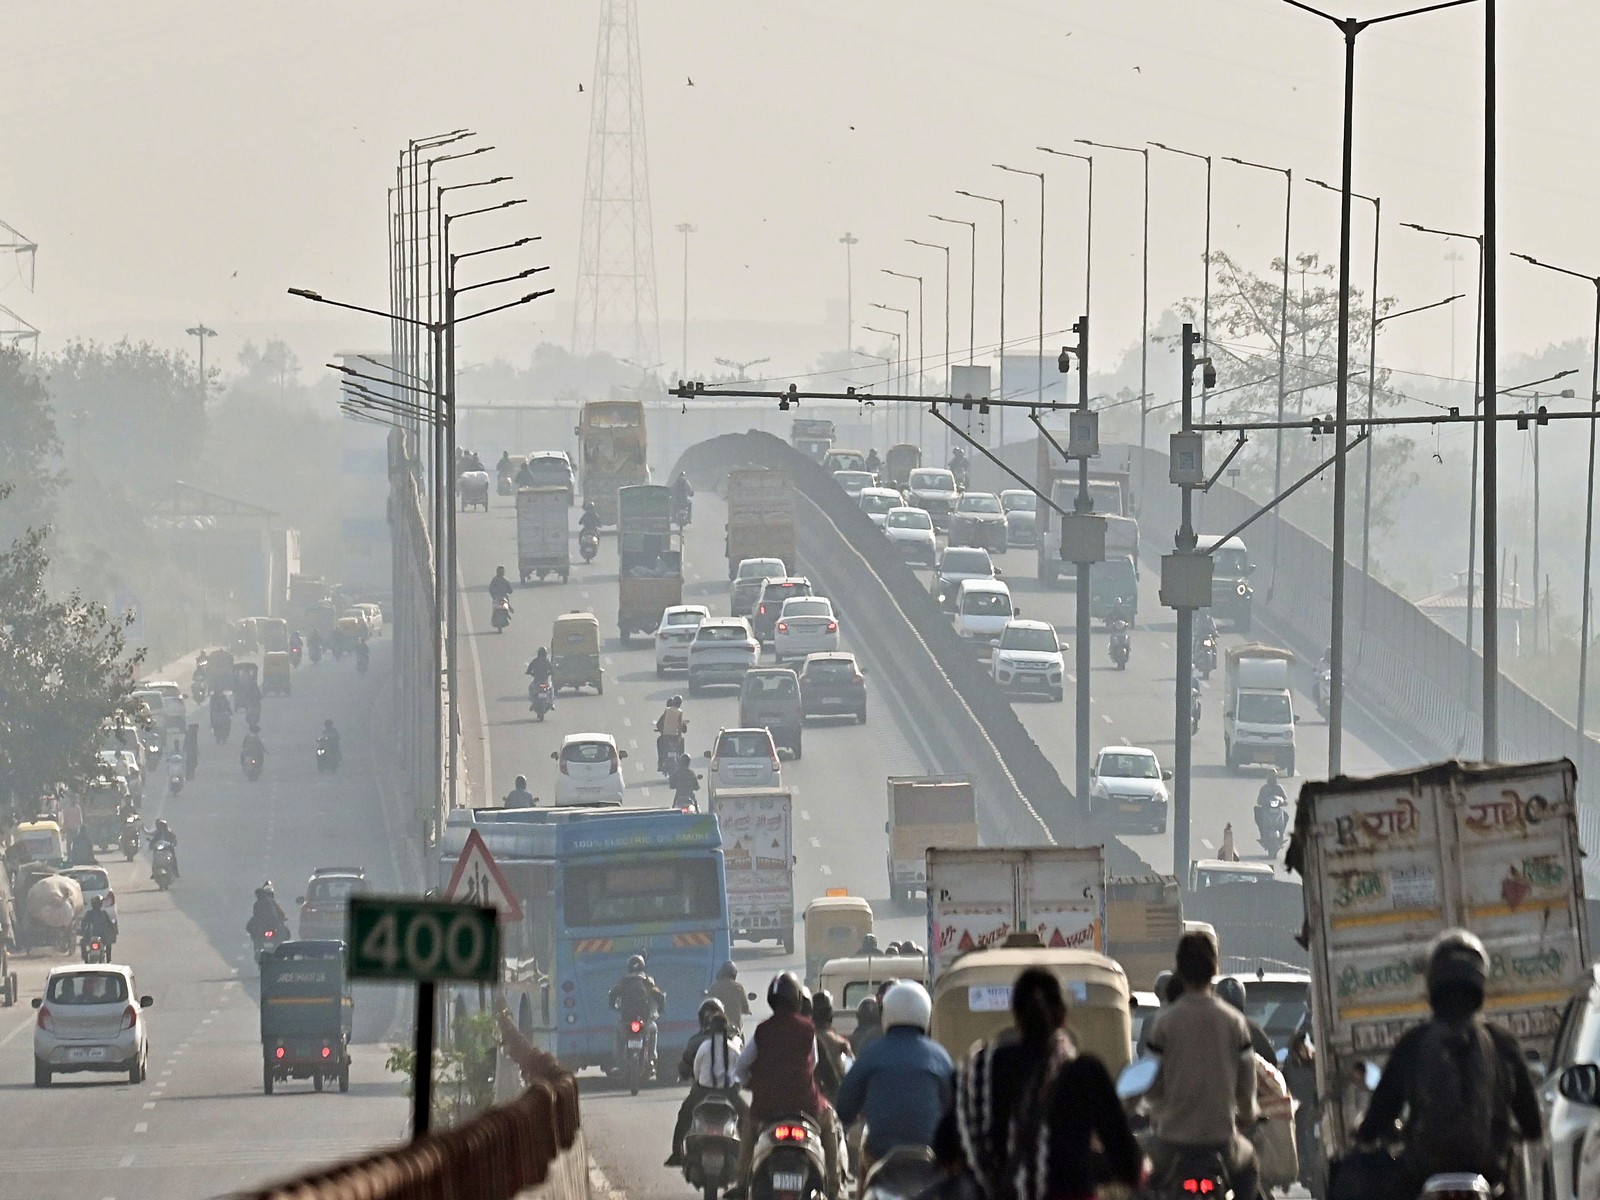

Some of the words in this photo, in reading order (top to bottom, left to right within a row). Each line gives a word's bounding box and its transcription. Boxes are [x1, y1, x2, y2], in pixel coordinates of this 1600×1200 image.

[1361, 797, 1420, 841] राधे
[1465, 789, 1526, 834] राधे
[362, 912, 484, 972] 400
